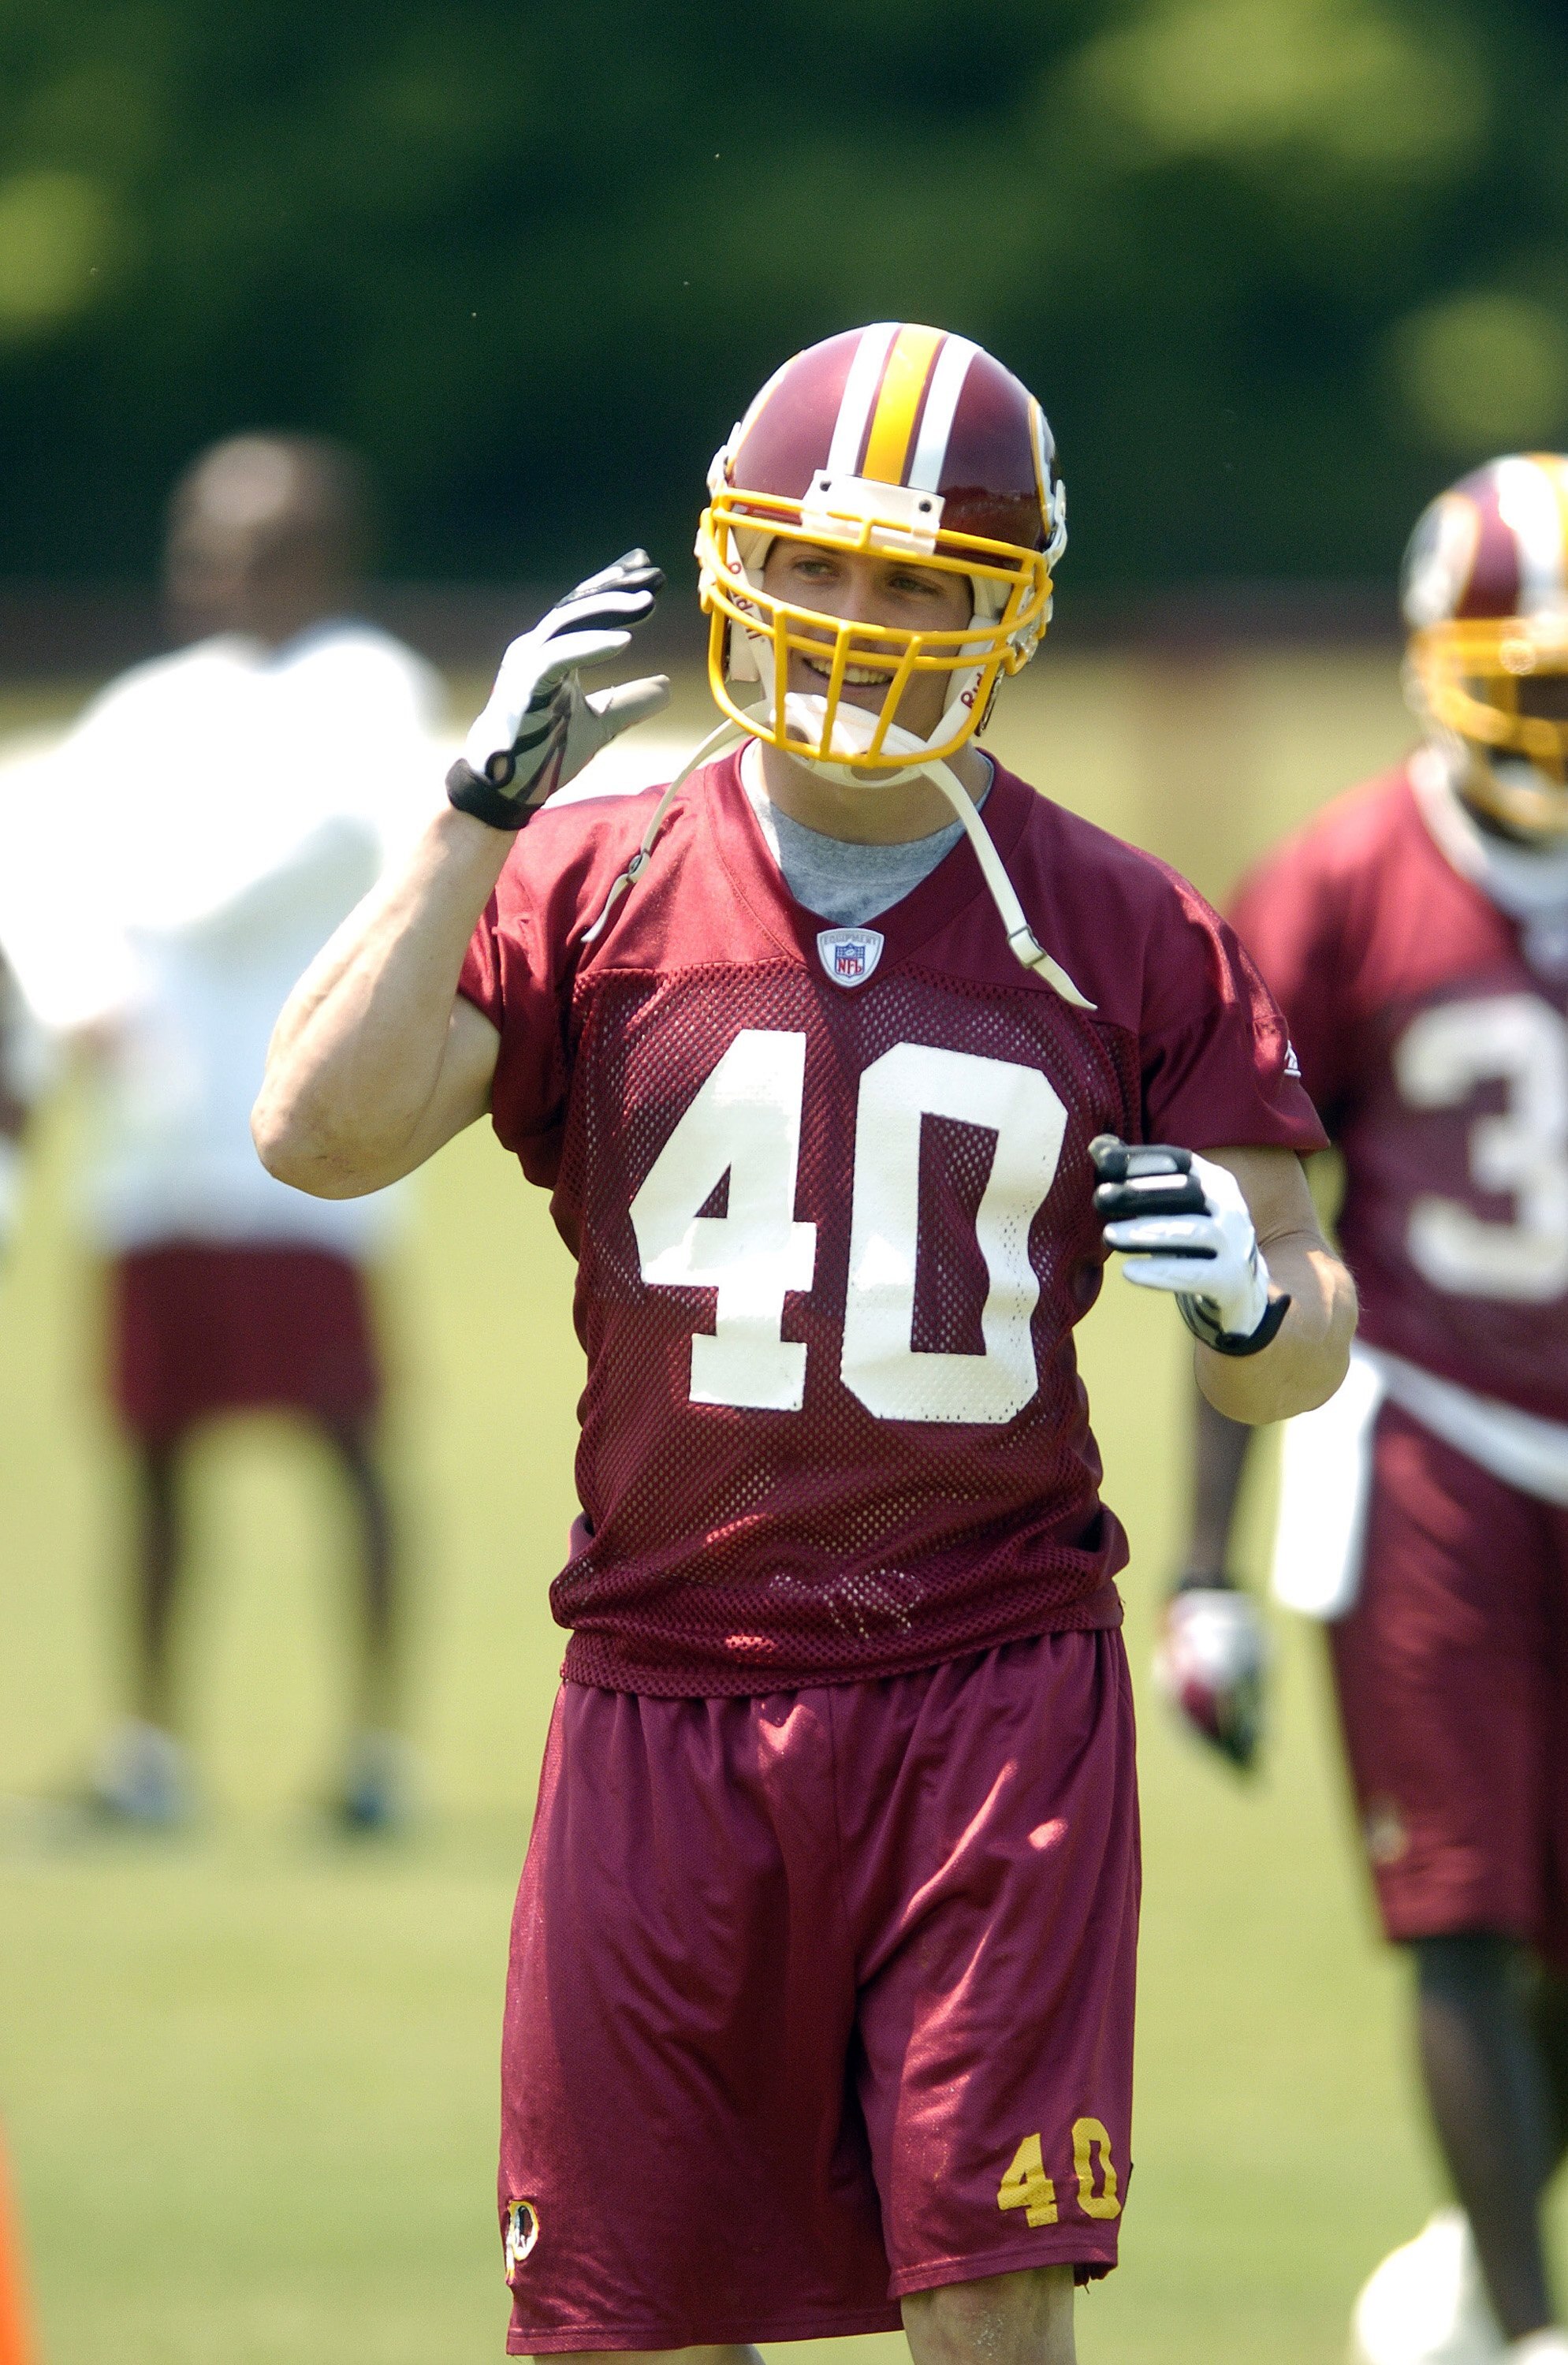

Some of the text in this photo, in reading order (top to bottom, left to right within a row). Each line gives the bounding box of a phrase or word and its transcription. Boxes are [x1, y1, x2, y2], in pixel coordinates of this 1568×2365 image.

[836, 957, 862, 975] NFL
[629, 1029, 1068, 1424] 40
[996, 2117, 1122, 2228] 40
